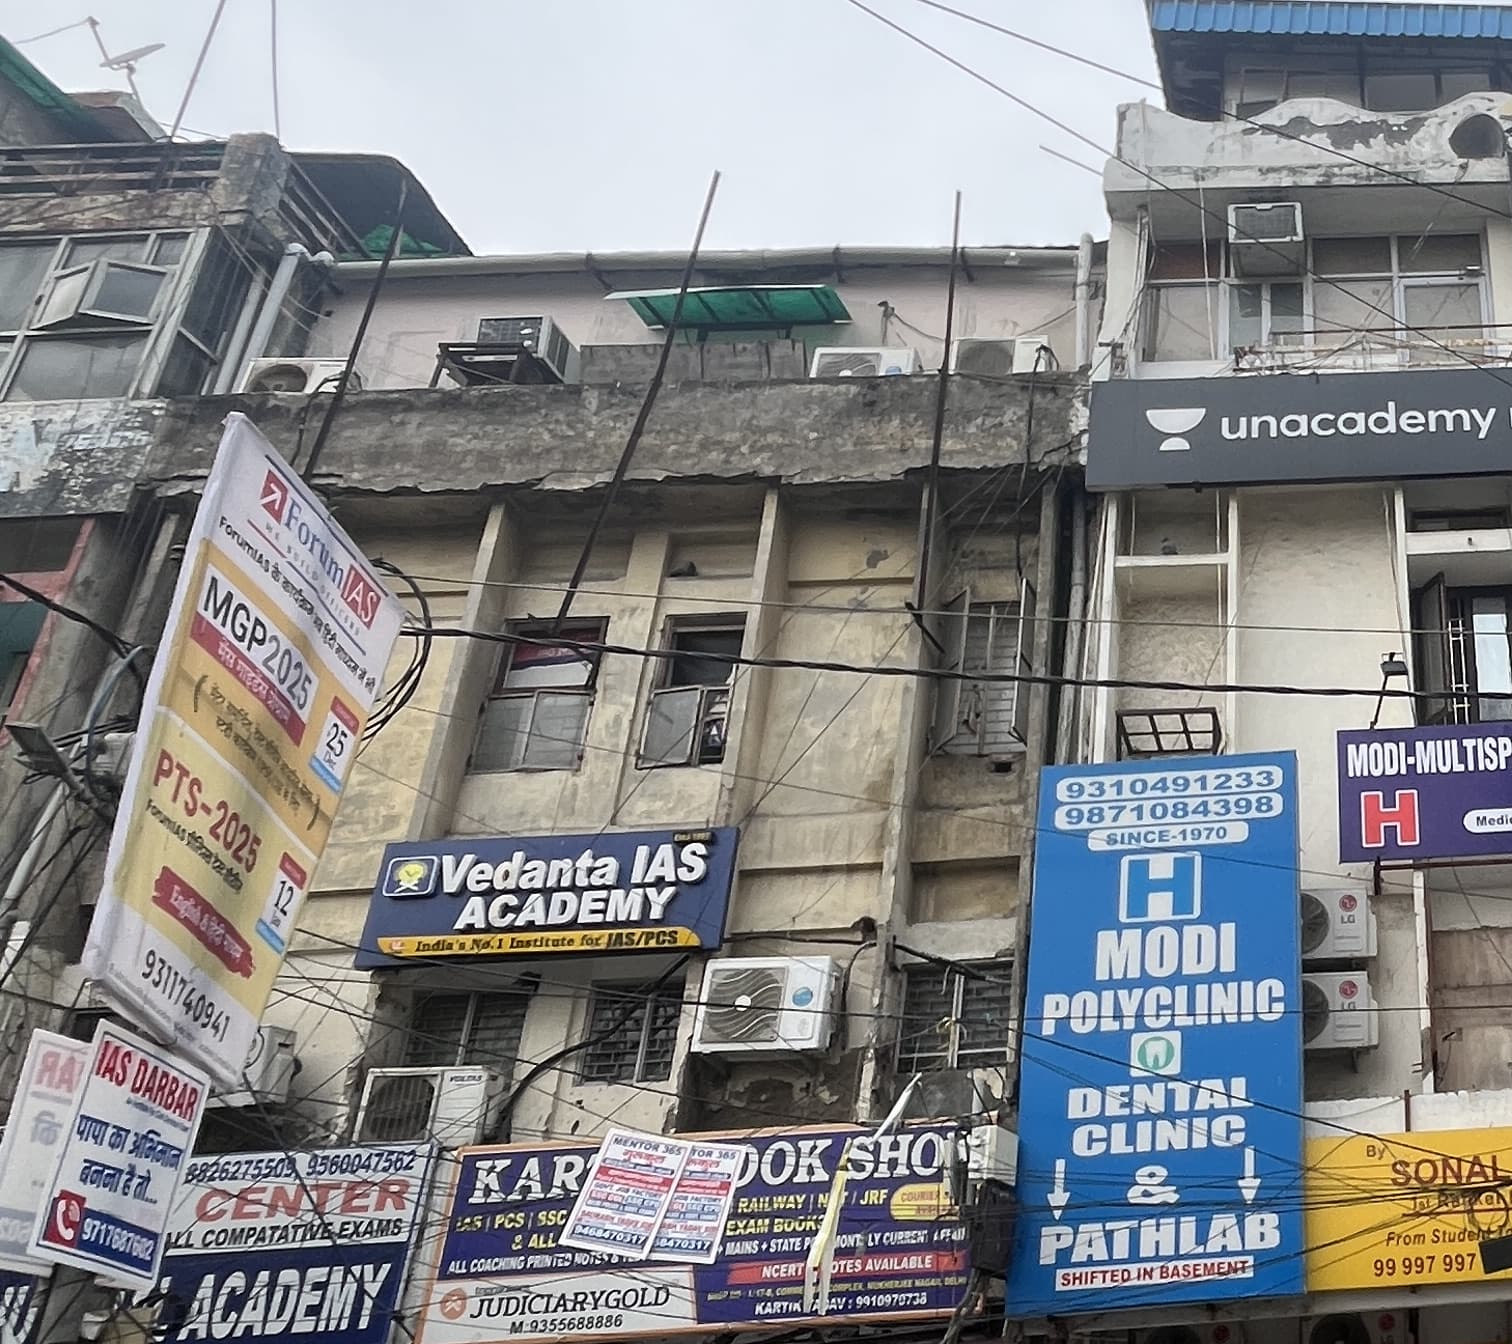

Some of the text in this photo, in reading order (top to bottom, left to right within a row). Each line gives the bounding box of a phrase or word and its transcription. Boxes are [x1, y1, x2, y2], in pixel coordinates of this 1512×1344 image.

[1220, 401, 1497, 442] unacademy
[218, 516, 271, 574] ForumIAS
[326, 721, 348, 757] 25
[1064, 769, 1276, 800] 9310491233
[153, 748, 262, 874] PTS-2025
[1063, 795, 1275, 826] 9871084398
[1105, 826, 1229, 847] SINCE-1970
[439, 841, 710, 894] Vedanta IAS
[273, 879, 295, 917] 12
[452, 883, 678, 932] ACADEMY
[414, 929, 681, 953] India's Institute for IAS/PCS
[1095, 921, 1237, 982] MODI
[1041, 977, 1286, 1036] POLYCLINIC
[96, 1040, 132, 1088] IAS
[130, 1058, 200, 1123] DARBAR
[1067, 1076, 1255, 1120] DENTAL
[612, 1136, 683, 1157] MENTOR 365
[1071, 1114, 1248, 1157] CLINIC
[1365, 1143, 1387, 1160] By
[468, 1155, 600, 1205] KAR
[737, 1134, 834, 1187] OOK
[1390, 1155, 1512, 1188] SONAL
[194, 1179, 412, 1223] CENTER
[493, 1188, 889, 1229] PCS SSC RAILWAY JRF
[202, 1217, 403, 1249] COMPATATIVE EXAMS
[528, 1218, 770, 1249] ALL EXAM
[1038, 1212, 1281, 1266] PATHLAB
[1385, 1230, 1426, 1248] From
[1430, 1225, 1494, 1245] Student
[447, 1237, 802, 1275] ALL COACHING PRINTED MAINS STATE
[761, 1255, 933, 1278] NCERT AVAILABLE
[1060, 1259, 1250, 1287] SHIFTED IN BASEMENT
[1372, 1258, 1397, 1278] 99
[1401, 1255, 1437, 1275] 997
[1442, 1252, 1477, 1273] 997
[176, 1262, 393, 1343] ACADEMY
[469, 1285, 671, 1320] JUDICIARYGOLD
